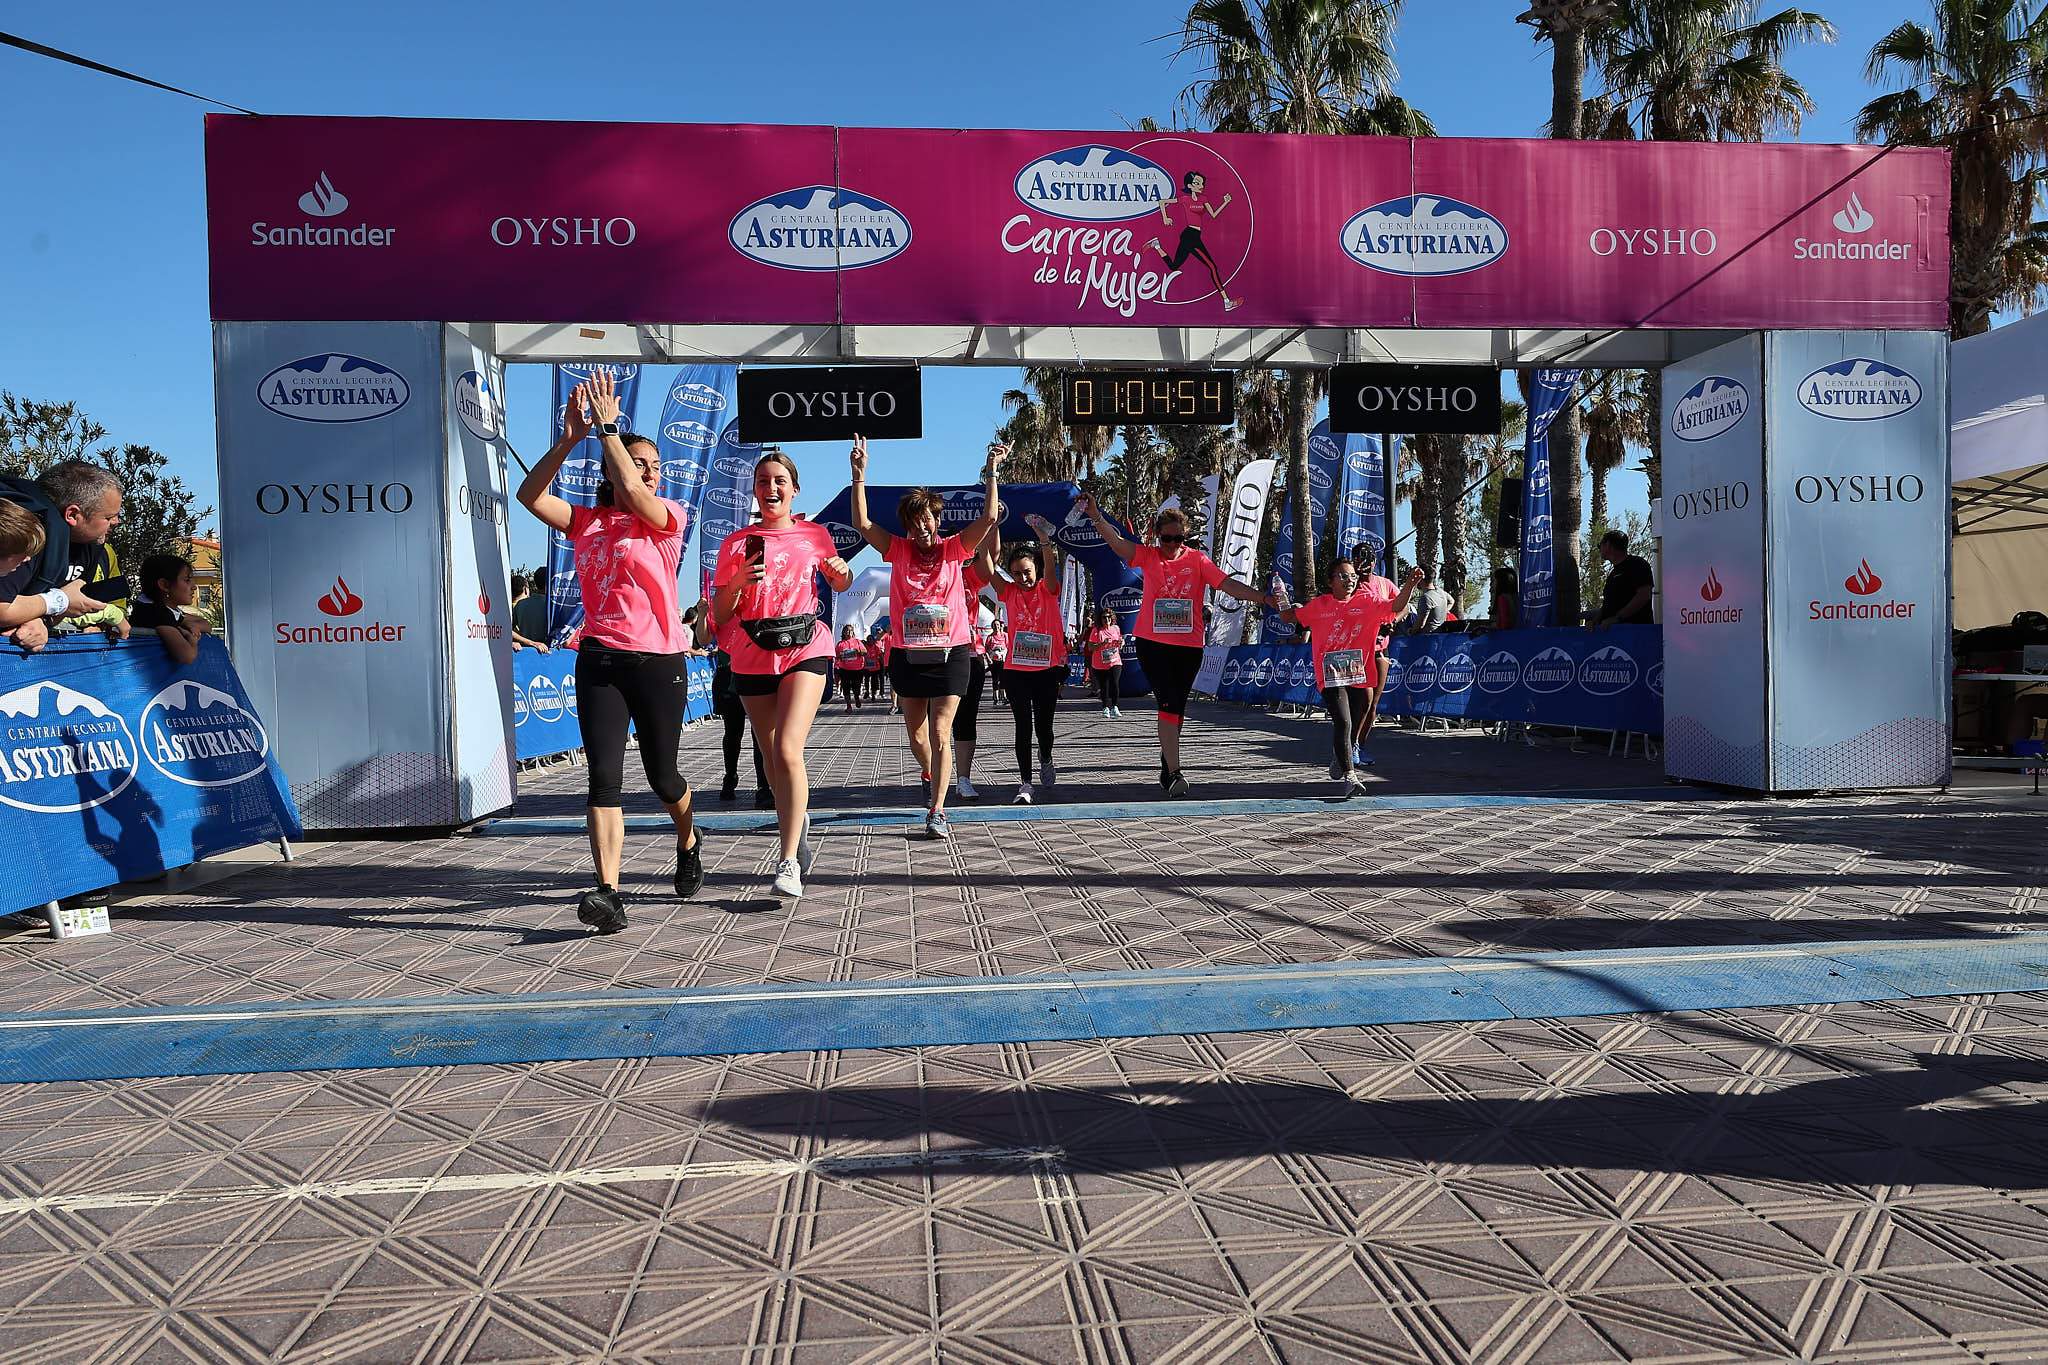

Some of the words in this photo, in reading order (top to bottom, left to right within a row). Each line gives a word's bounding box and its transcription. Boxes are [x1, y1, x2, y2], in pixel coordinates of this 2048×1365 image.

[1027, 171, 1161, 202] ASTURIANA
[1052, 170, 1101, 179] CENTRAL
[1106, 171, 1158, 180] LECHERA
[490, 217, 637, 246] OYSHO
[771, 215, 828, 223] CENTRAL
[1379, 222, 1432, 230] CENTRAL
[1436, 223, 1490, 231] LECHERA
[252, 222, 396, 246] Santander
[743, 217, 898, 249] ASTURIANA
[1001, 214, 1134, 256] Carrera
[1354, 223, 1496, 254] ASTURIANA
[1589, 228, 1717, 256] OYSHO
[1794, 238, 1911, 260] Santander
[1034, 259, 1058, 284] de
[1064, 256, 1081, 285] la
[1078, 253, 1182, 317] Mujer
[269, 379, 399, 405] ASTURIANA
[1807, 382, 1913, 405] ASTURIANA
[1825, 379, 1865, 387] CENTRAL
[1868, 379, 1908, 387] LECHERA
[676, 389, 722, 408] ASTURIANA
[768, 391, 896, 418] OYSHO
[1075, 381, 1221, 414] 01:04:54
[1357, 386, 1477, 412] OYSHO
[1676, 399, 1742, 432] ASTURIANA
[667, 427, 714, 443] ASTURIANA
[256, 483, 413, 514] OYSHO
[1673, 482, 1749, 520] OYSHO
[1795, 475, 1924, 503] OYSHO
[459, 485, 504, 526] OYSHO
[1680, 605, 1743, 625] Santander
[1809, 600, 1915, 620] Santander
[276, 622, 406, 644] Santander
[467, 619, 503, 640] Santander
[1526, 665, 1570, 681] ASTURIANA
[1582, 664, 1631, 683] ASTURIANA
[8, 725, 63, 740] CENTRAL
[166, 716, 207, 728] CENTRAL
[153, 720, 260, 763] ASTURIAN
